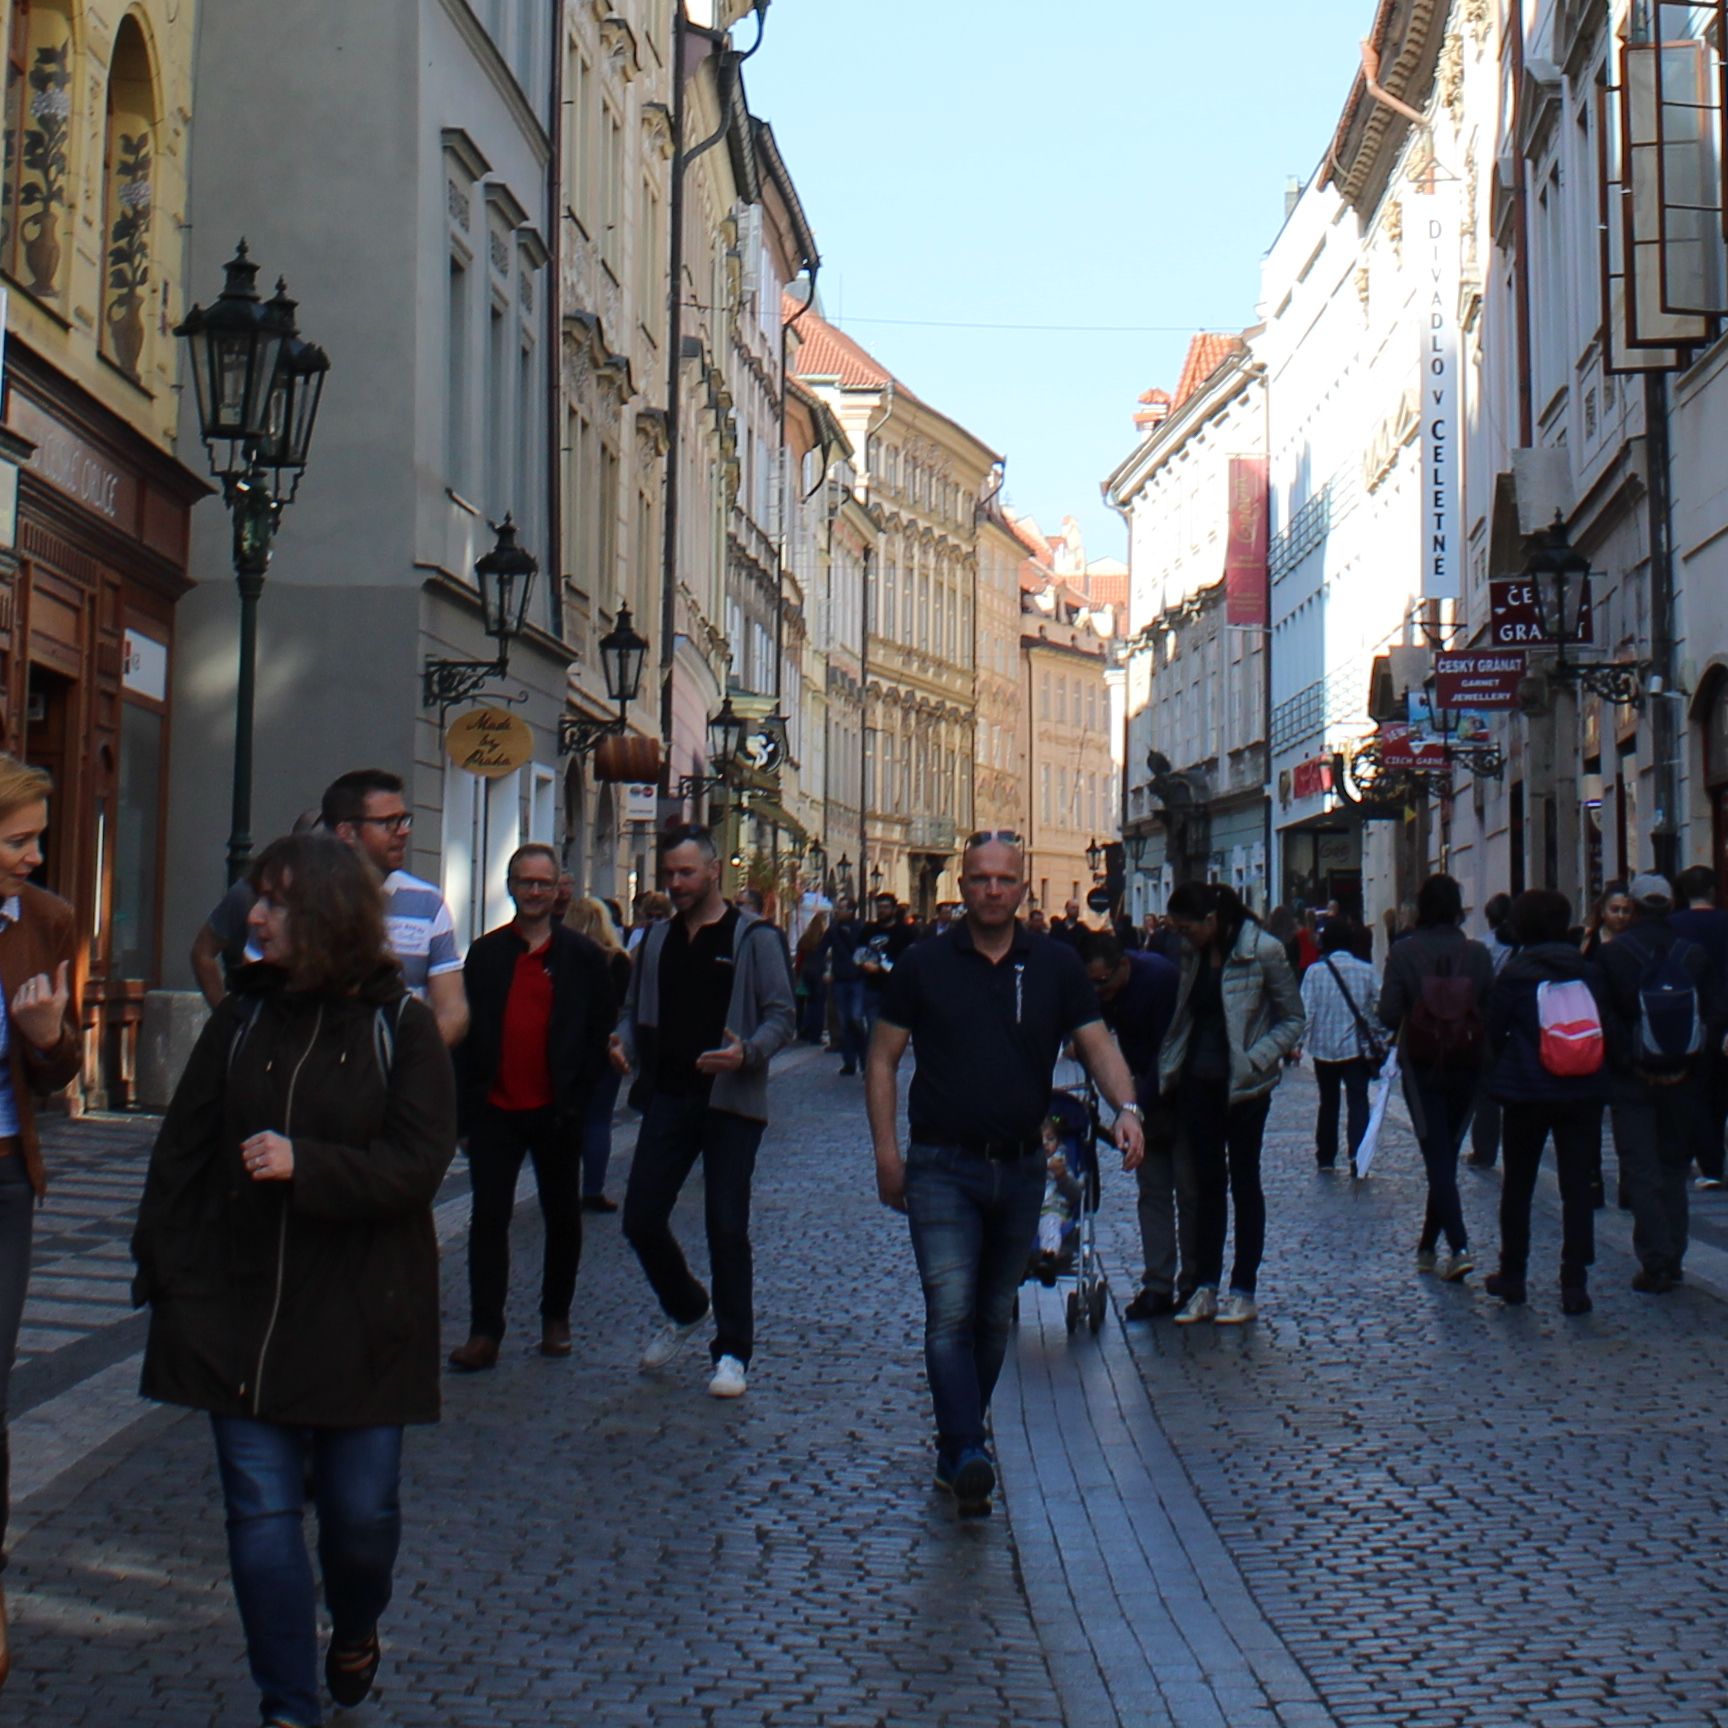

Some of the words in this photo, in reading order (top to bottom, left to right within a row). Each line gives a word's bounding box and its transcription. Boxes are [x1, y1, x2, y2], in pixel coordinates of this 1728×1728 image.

[1428, 220, 1445, 376] DIVADLO
[1431, 419, 1446, 576] CELETNÉ
[1415, 756, 1449, 766] GARNE
